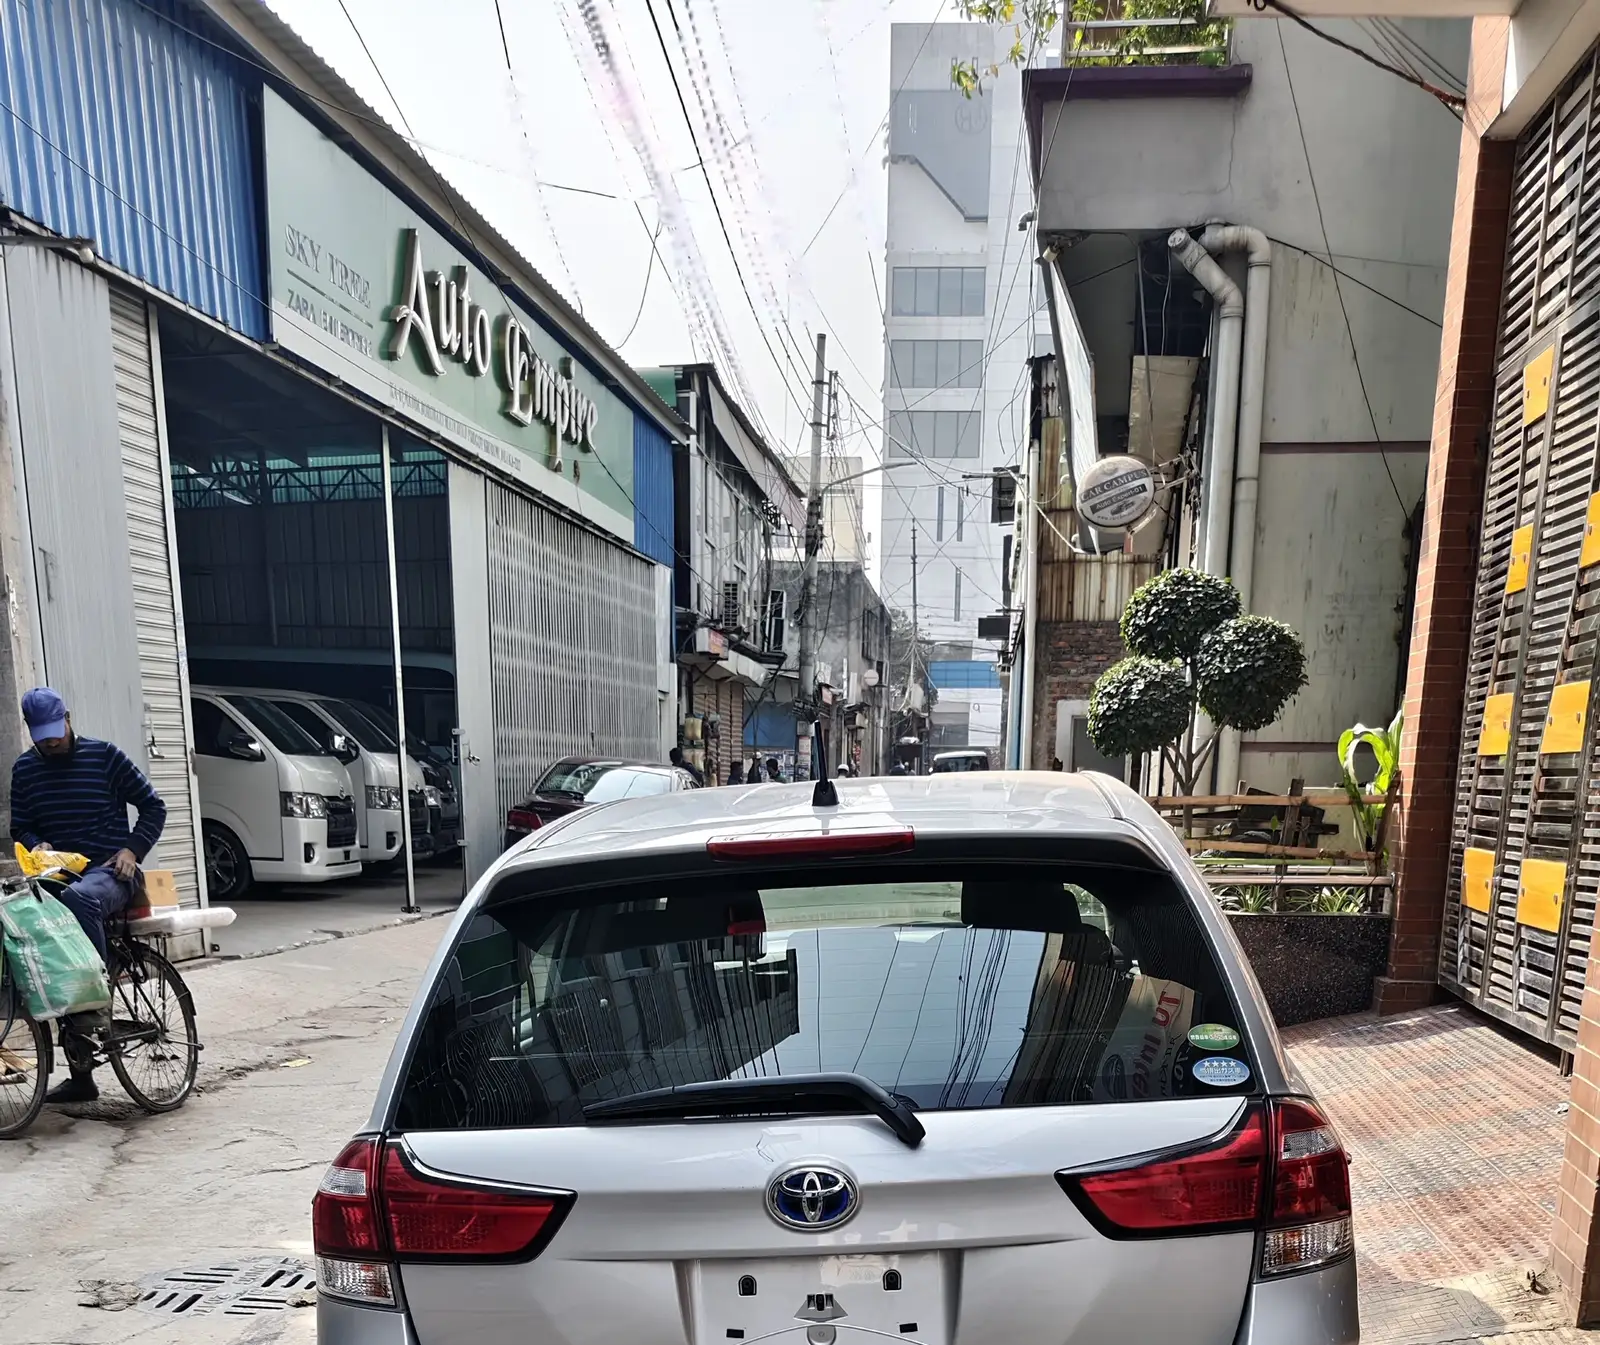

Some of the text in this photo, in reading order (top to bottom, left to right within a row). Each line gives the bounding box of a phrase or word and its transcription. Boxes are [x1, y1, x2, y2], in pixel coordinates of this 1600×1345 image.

[285, 223, 371, 309] SKY TREE
[287, 288, 317, 325] ZARA
[391, 228, 491, 377] Auto
[502, 314, 599, 472] Empire
[1081, 486, 1104, 502] CAR
[1103, 469, 1148, 491] CAMPUS
[1095, 500, 1111, 510] Auto
